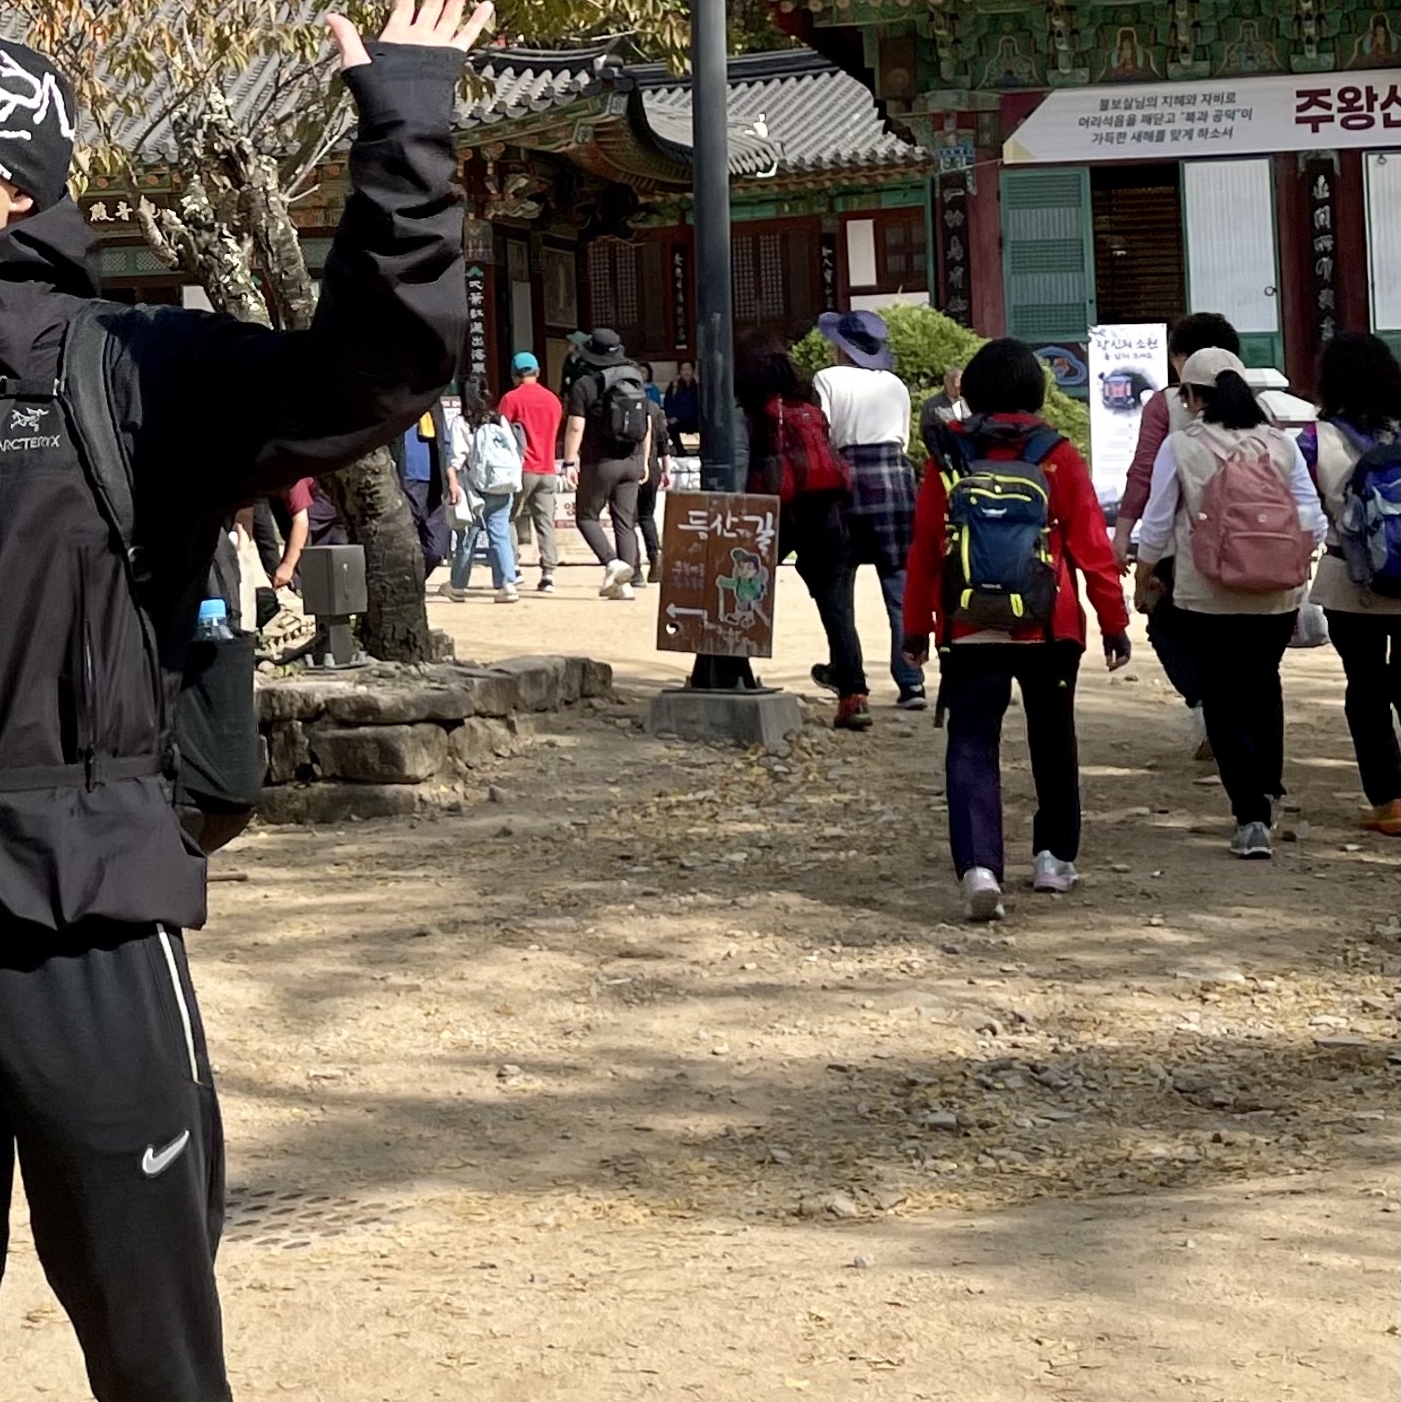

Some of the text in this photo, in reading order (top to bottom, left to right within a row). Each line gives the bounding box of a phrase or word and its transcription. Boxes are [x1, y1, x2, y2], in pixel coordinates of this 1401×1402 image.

[1161, 94, 1197, 108] 지혜와
[1200, 92, 1237, 106] 자비로
[1078, 113, 1136, 129] 어리석음을
[1140, 111, 1176, 126] 깨닫고
[1092, 131, 1127, 145] 가득한
[1130, 129, 1166, 143] 새해를
[1197, 126, 1234, 140] 하소서
